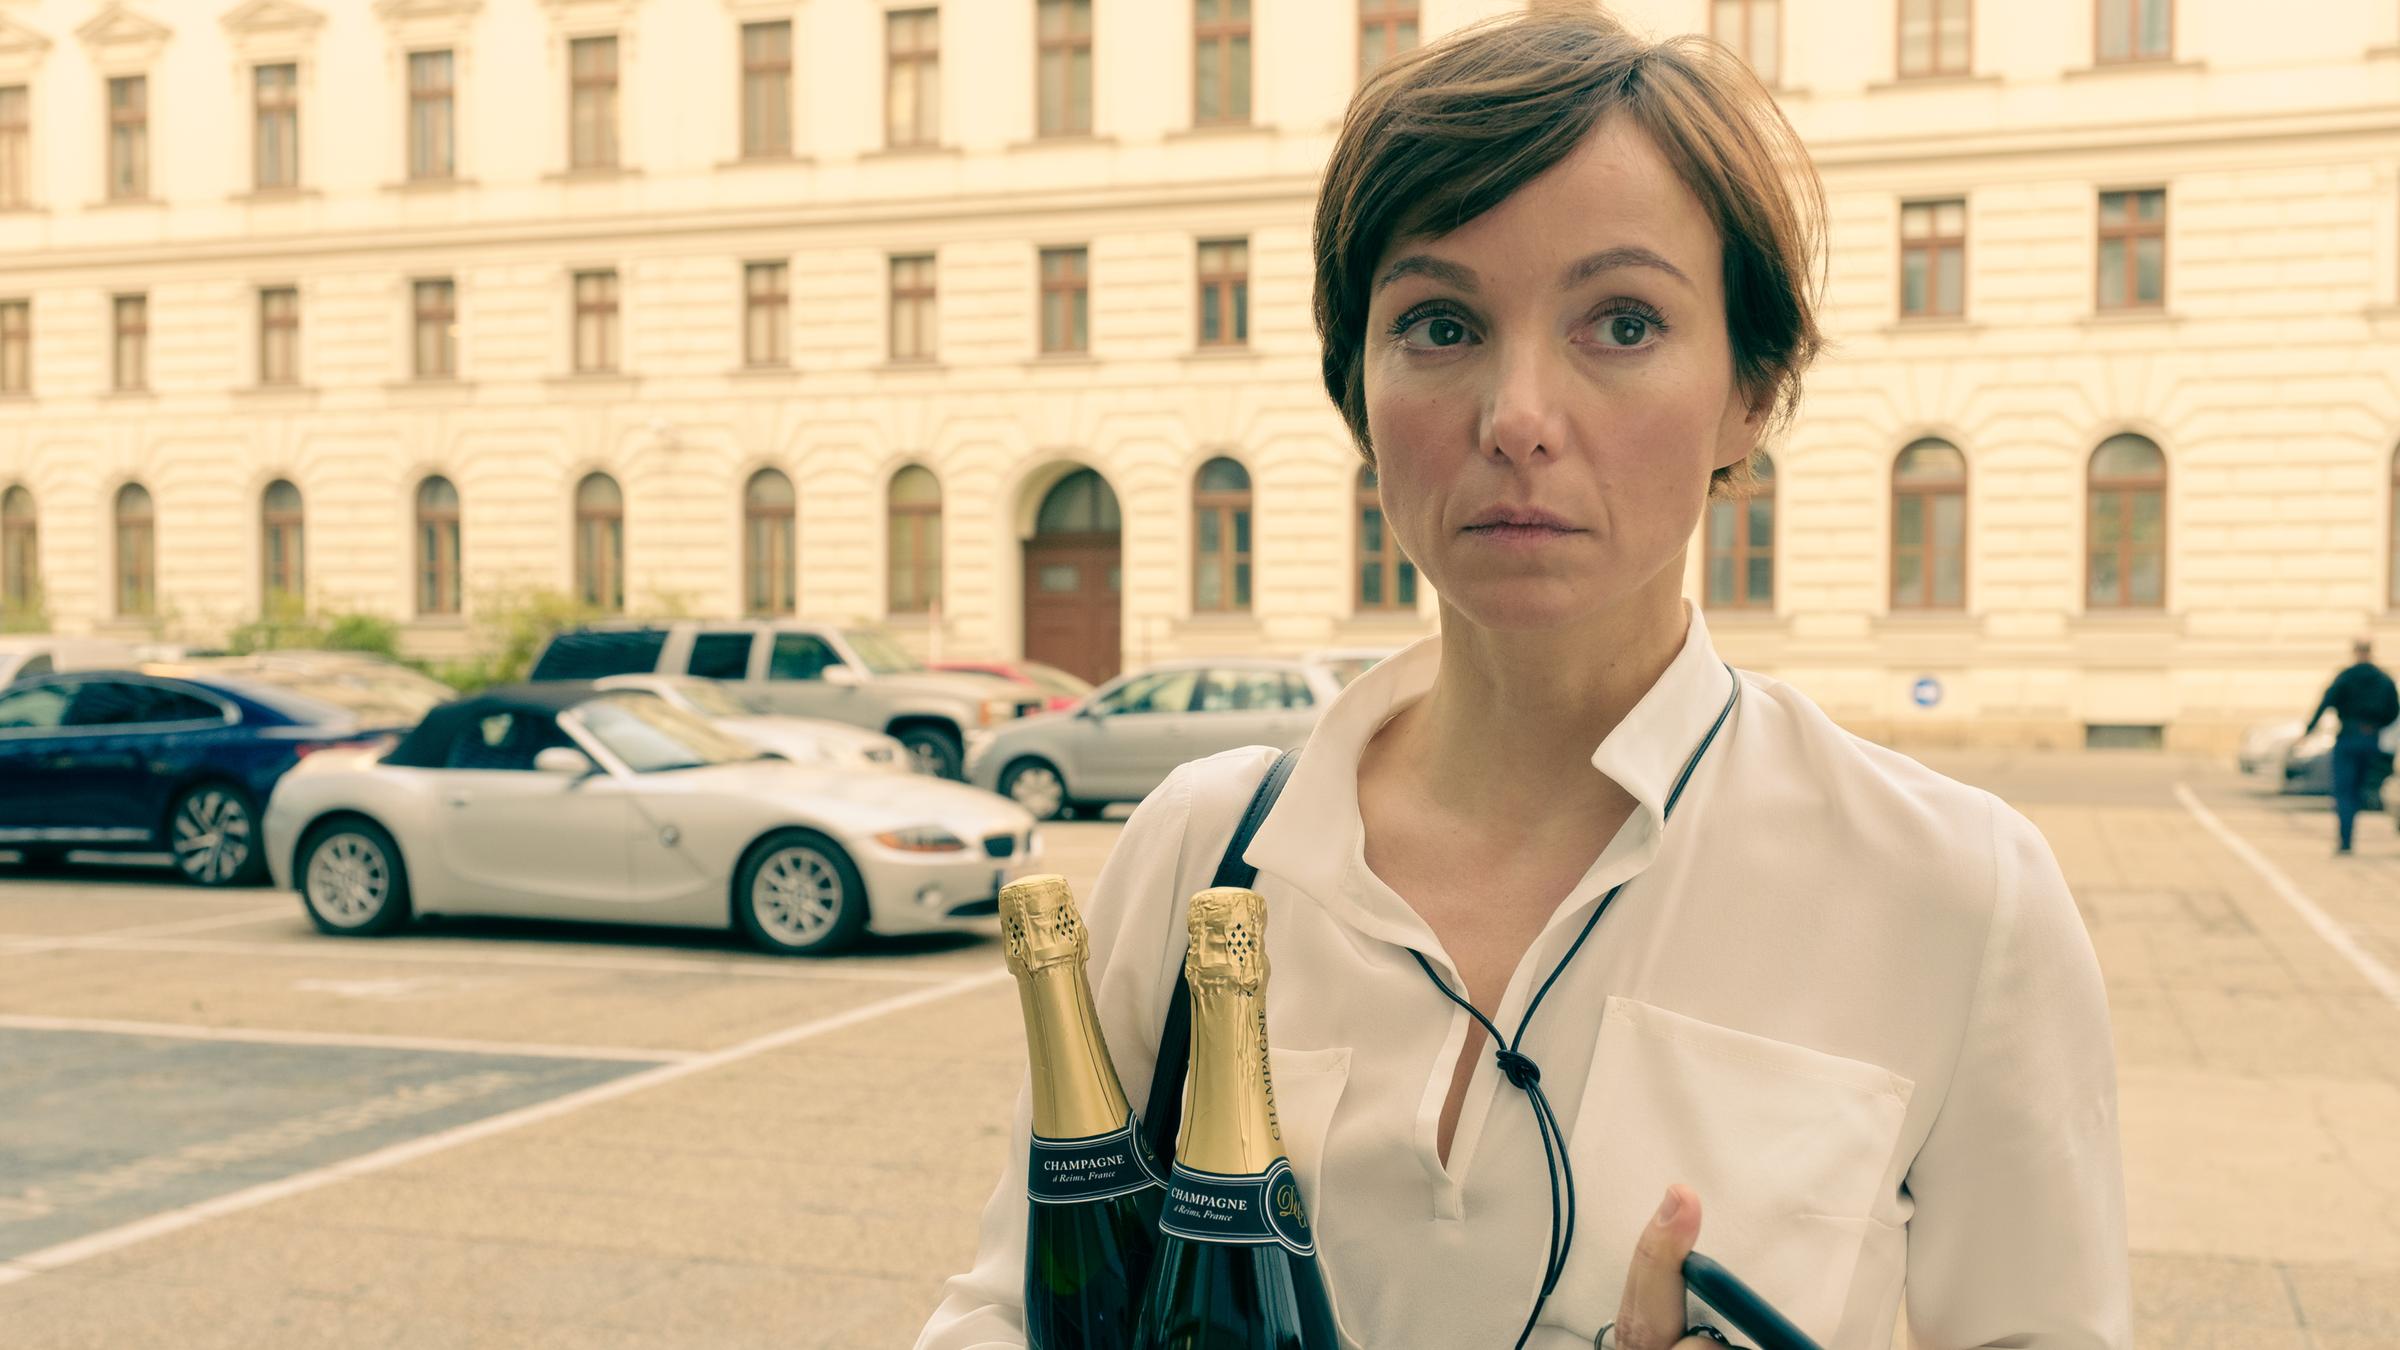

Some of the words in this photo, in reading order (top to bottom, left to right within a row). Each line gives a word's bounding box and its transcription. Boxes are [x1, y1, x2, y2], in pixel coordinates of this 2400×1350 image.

[1257, 1007, 1281, 1141] CHAMPAGNE
[1044, 1154, 1125, 1171] CHAMPAGNE
[1059, 1174, 1086, 1183] Reims,
[1088, 1170, 1116, 1181] France
[1171, 1187, 1248, 1211] CHAMPAGNE
[1178, 1204, 1201, 1218] Reims,
[1203, 1209, 1233, 1222] France
